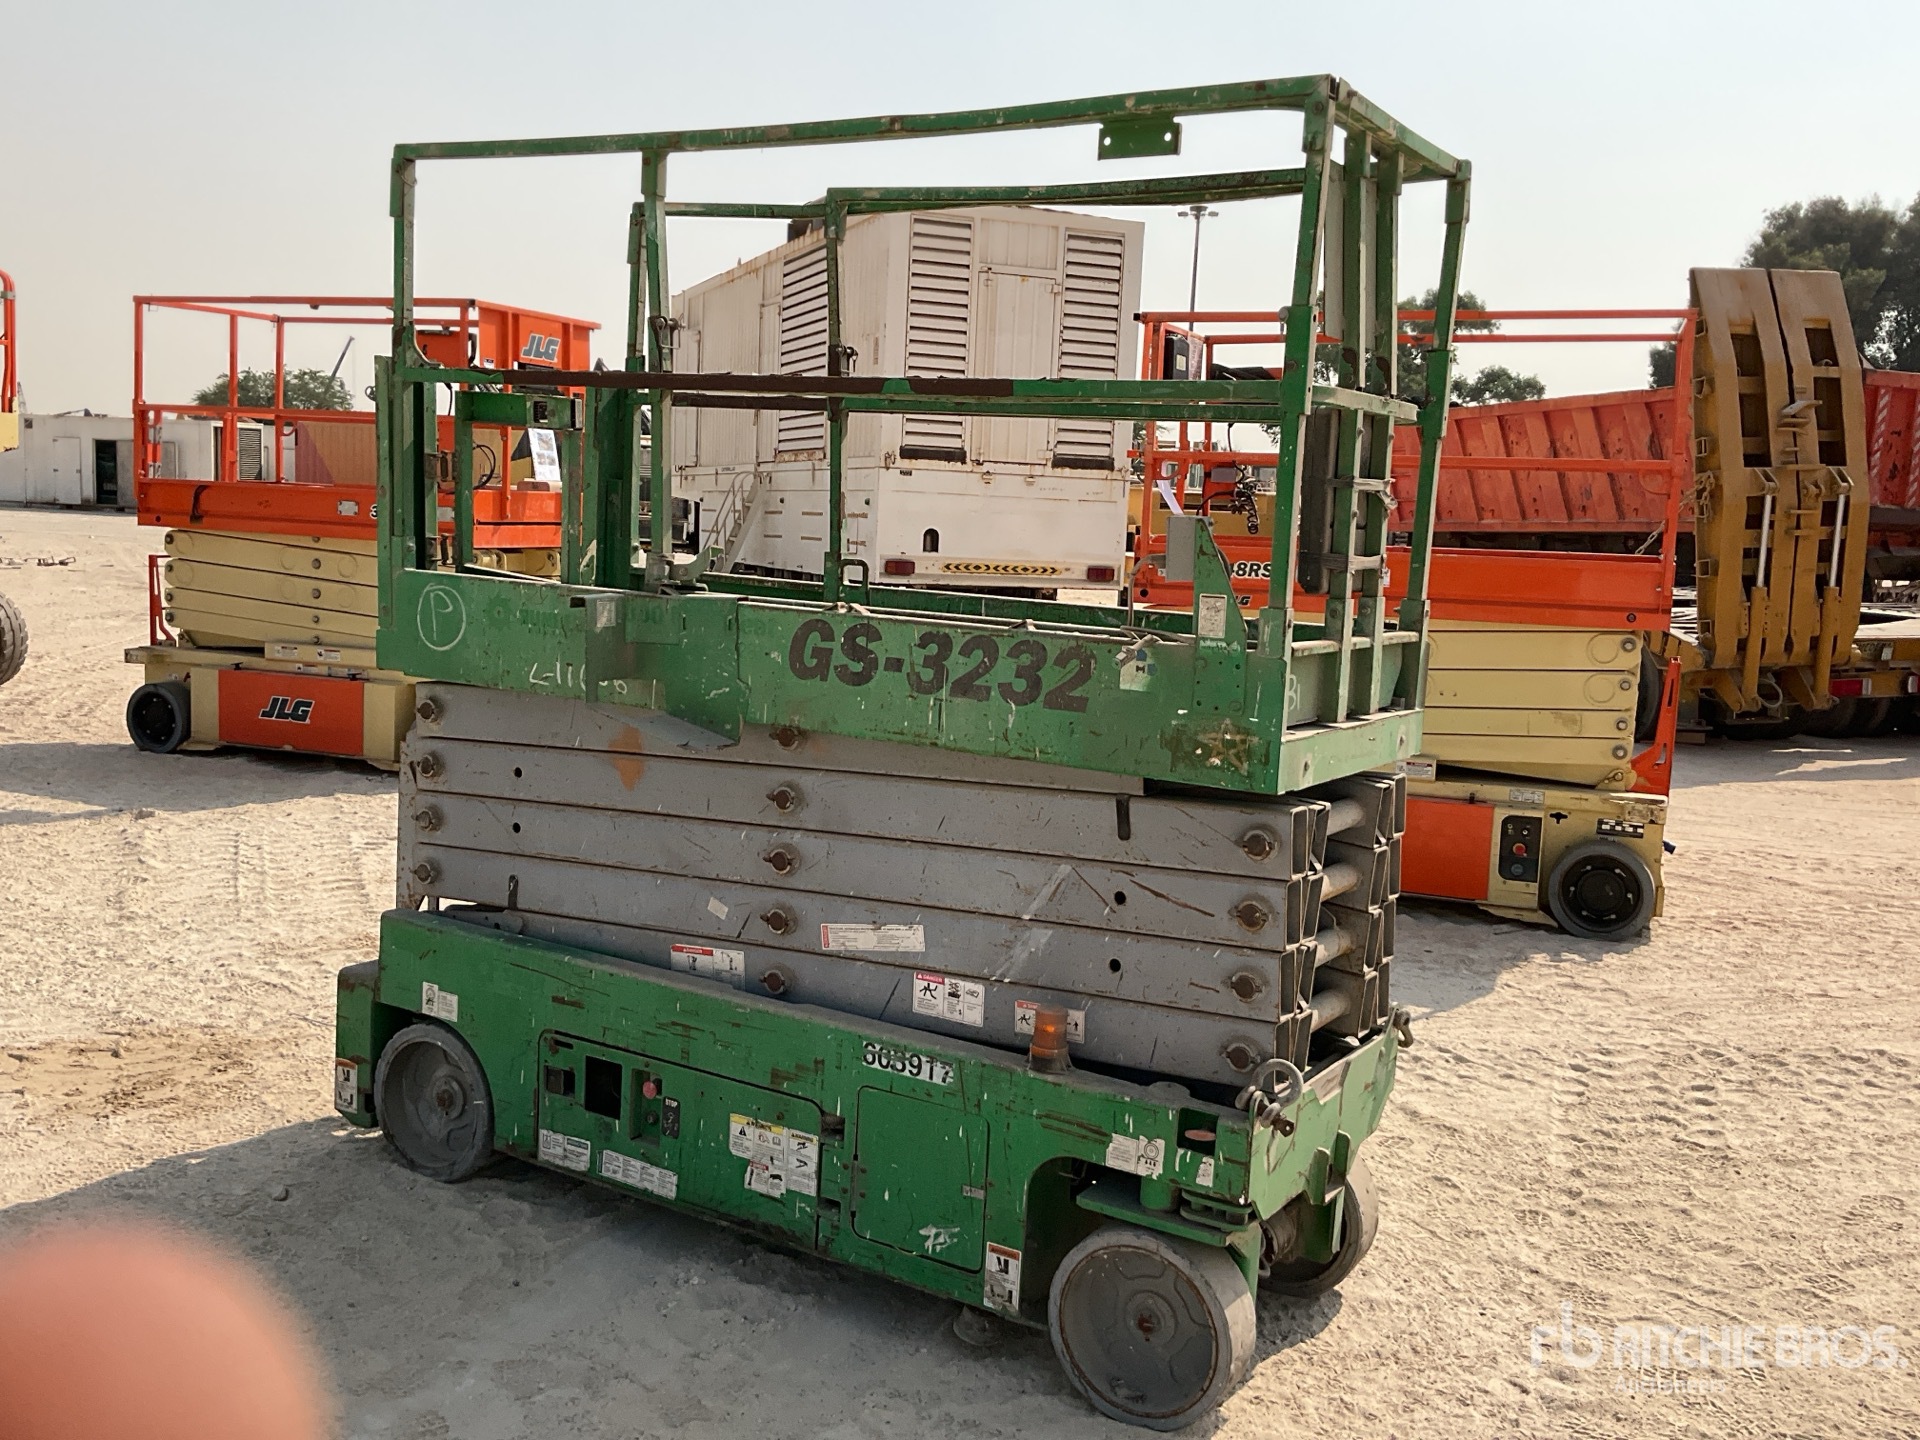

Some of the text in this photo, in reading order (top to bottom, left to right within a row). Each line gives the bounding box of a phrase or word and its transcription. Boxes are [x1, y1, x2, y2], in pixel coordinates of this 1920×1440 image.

[520, 333, 561, 363] JLG
[788, 617, 1097, 713] GS-3232
[258, 695, 316, 725] JLG
